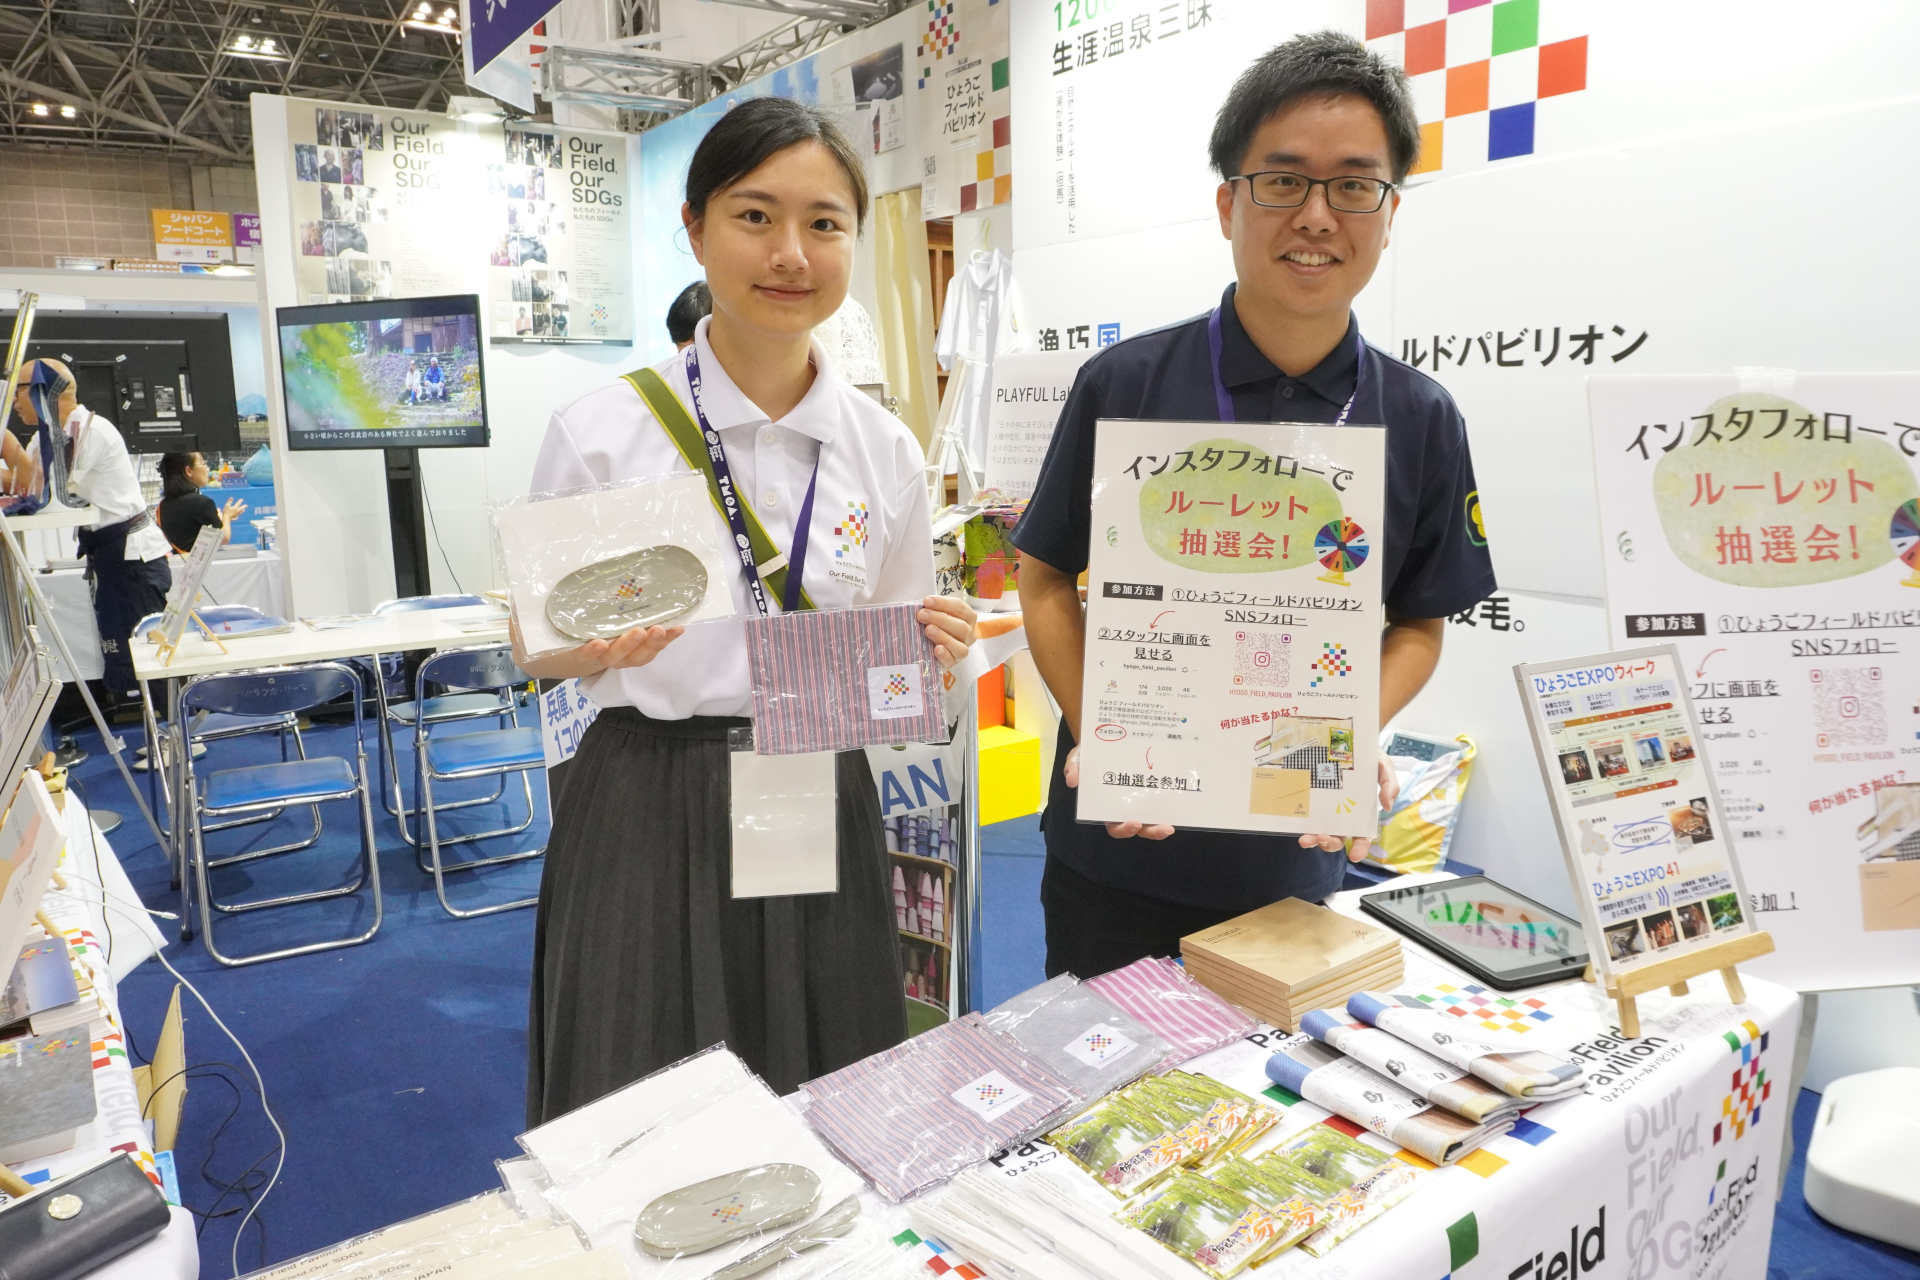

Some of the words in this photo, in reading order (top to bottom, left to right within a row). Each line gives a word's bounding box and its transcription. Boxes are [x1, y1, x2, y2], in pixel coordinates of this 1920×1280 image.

[947, 74, 981, 99] ひょうご
[945, 91, 985, 117] フィールド
[390, 116, 430, 135] Our
[943, 111, 986, 135] パビリオン
[569, 137, 603, 154] Our
[393, 153, 431, 171] Our
[571, 154, 618, 175] Field,
[395, 171, 453, 190] SDG
[570, 171, 604, 187] Our
[572, 188, 622, 206] SDGs
[170, 213, 213, 224] ジャパン
[161, 225, 224, 236] フードコート
[997, 387, 1049, 402] PLAYFUL
[1625, 407, 1920, 461] インスタフォローで
[1123, 447, 1354, 492] インスタフォローで
[1690, 468, 1875, 507] ルーレット
[1165, 491, 1309, 520] ルーレット
[1111, 584, 1155, 597] 参加方法
[1172, 588, 1363, 611] ①ひょうごフィールドパビリオン
[1224, 610, 1307, 625] SNSフォロー
[1636, 616, 1696, 632] 参加方法
[1718, 609, 1920, 634] ①ひょうごフィールドパビ
[1098, 627, 1211, 646] ②スタッフに画面を
[1134, 647, 1173, 661] 見せる
[1791, 638, 1899, 657] SNSフォロー
[1123, 663, 1176, 672] hyogo_field_pavilion
[1534, 660, 1655, 693] ひょうごEXPOウィーク
[1229, 689, 1292, 698] HYOGO_FIELD_PAVILION
[1688, 680, 1781, 700] フに画面を
[1220, 706, 1299, 730] 何が当たるかな？
[1699, 707, 1735, 724] せる
[1808, 770, 1906, 815] 何が当たるかな？
[1592, 861, 1681, 897] ひょうごEXPO41
[1625, 1085, 1683, 1155] Our
[332, 1251, 364, 1264] SDGs
[379, 1263, 411, 1275] SDGs
